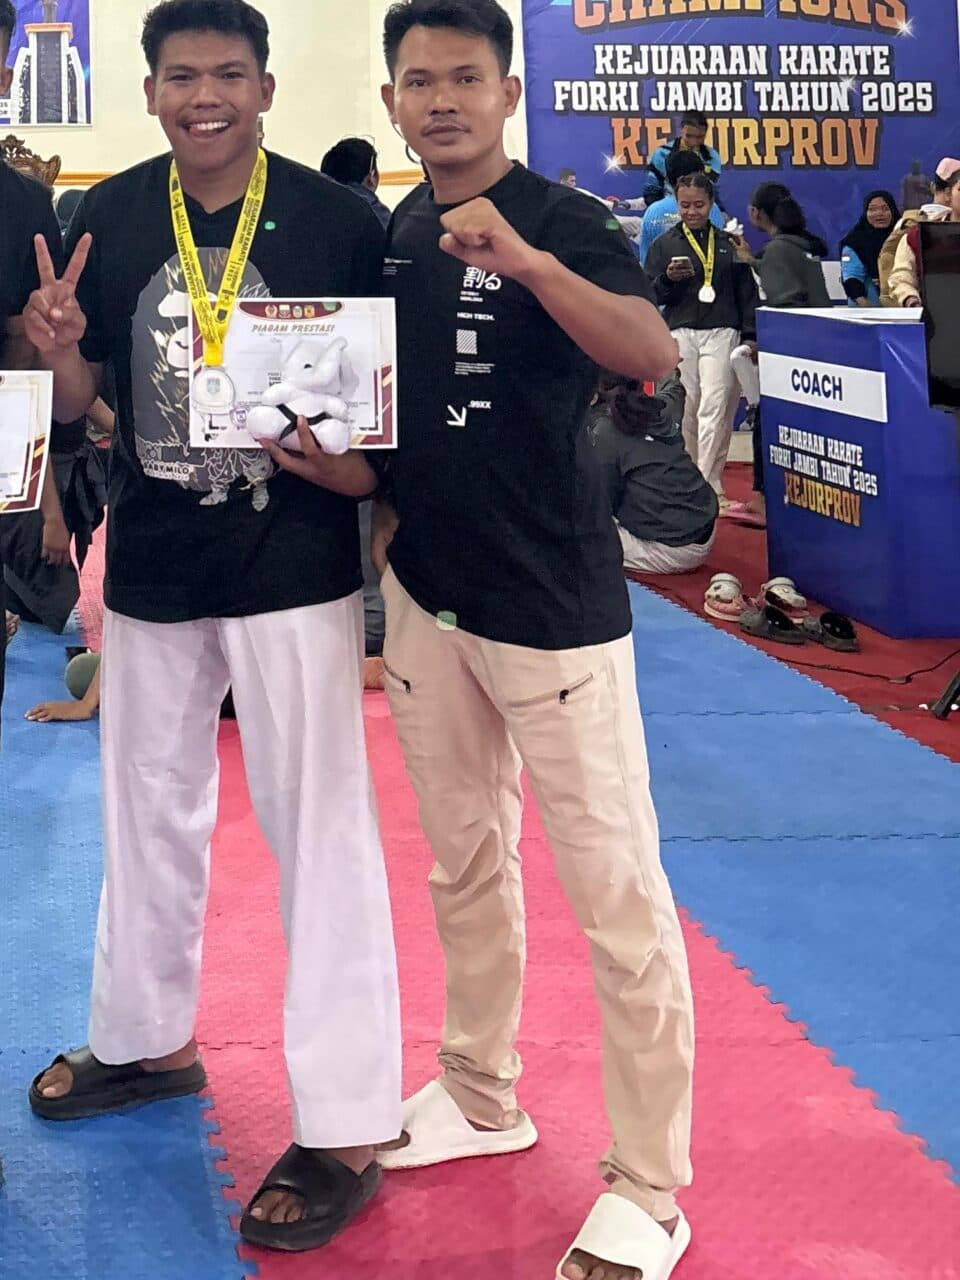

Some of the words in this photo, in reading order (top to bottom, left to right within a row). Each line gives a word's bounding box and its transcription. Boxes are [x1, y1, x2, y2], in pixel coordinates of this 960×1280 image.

[594, 44, 768, 76] KEJUARAAN
[779, 44, 890, 76] KARATE
[553, 80, 640, 112] FORKI
[651, 81, 741, 112] JAMBI
[754, 81, 851, 112] TAHUN
[862, 81, 933, 112] 2025
[611, 118, 879, 166] KEURPROV
[252, 323, 288, 333] PIAGAM
[291, 324, 335, 333] PRESTASI
[791, 368, 843, 401] COACH
[778, 424, 825, 457] KEJUARAAN
[827, 437, 863, 467] KARATE
[769, 444, 792, 469] FORKI
[793, 451, 819, 477] JAMBI
[820, 460, 850, 488] TAHUN
[852, 470, 878, 496] 2025
[784, 471, 861, 528] KEJURPROV
